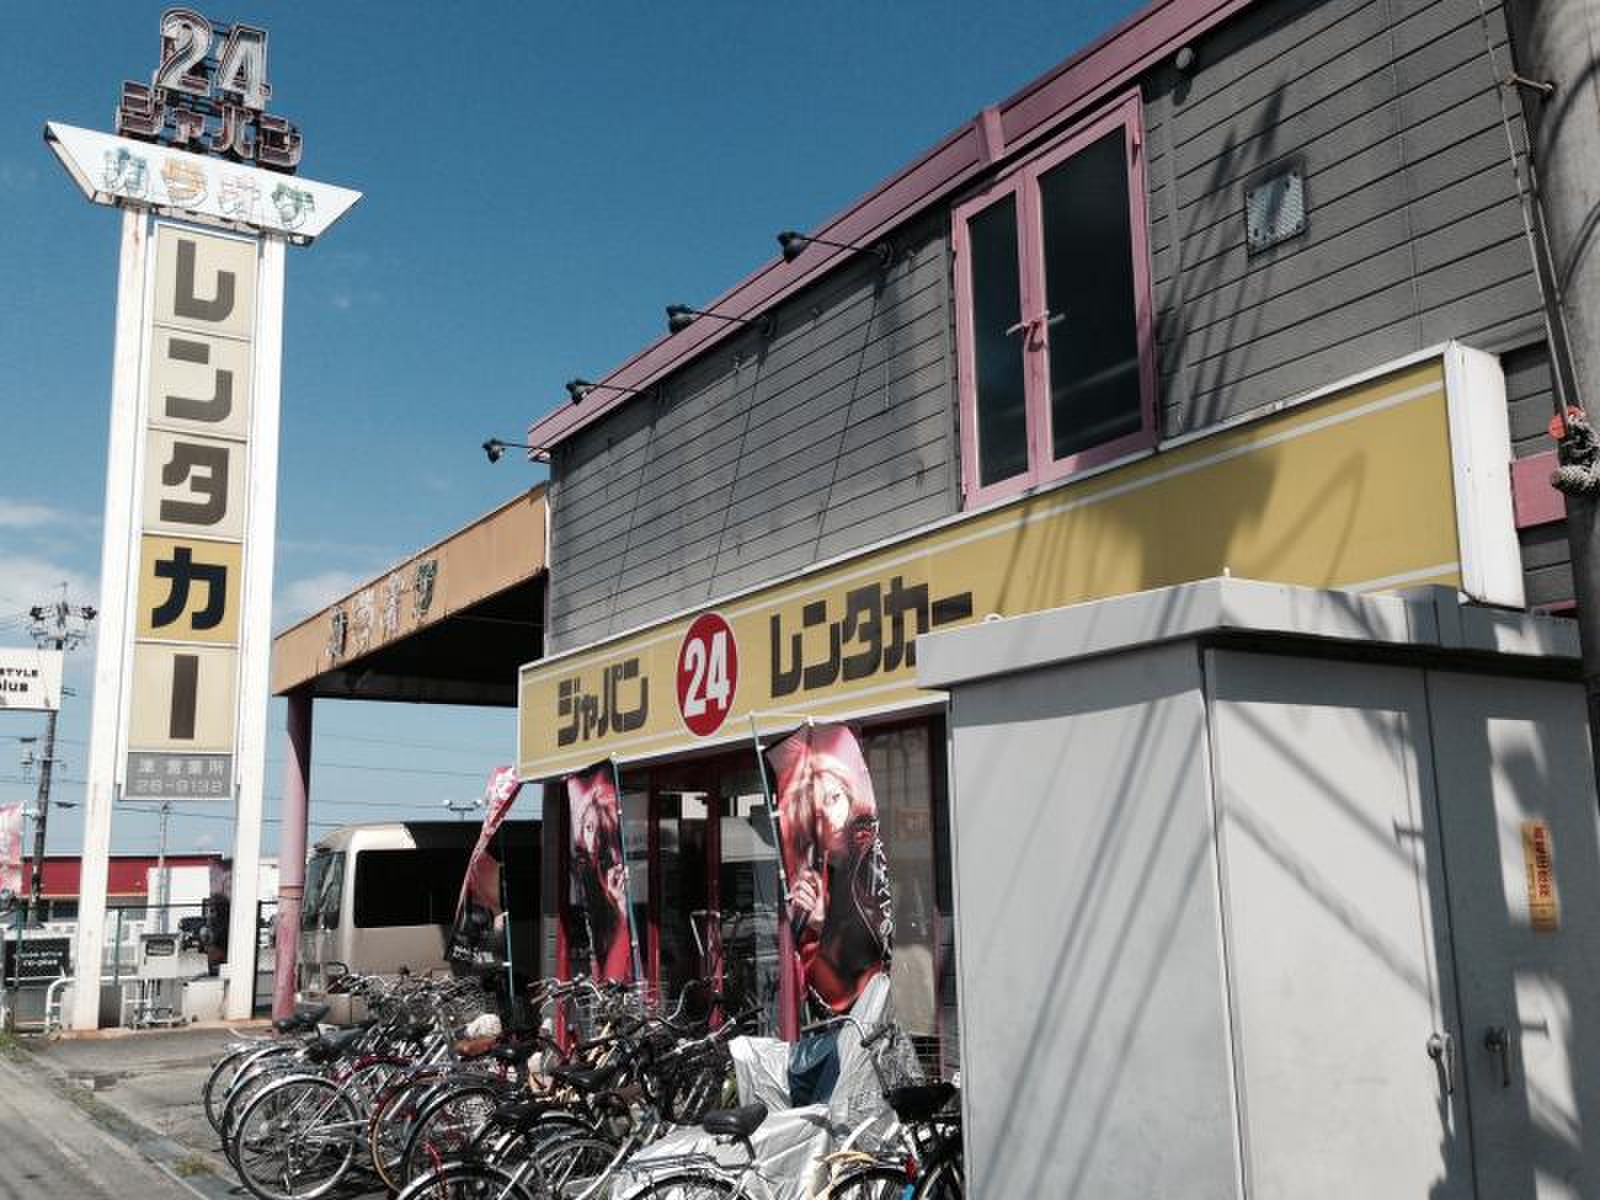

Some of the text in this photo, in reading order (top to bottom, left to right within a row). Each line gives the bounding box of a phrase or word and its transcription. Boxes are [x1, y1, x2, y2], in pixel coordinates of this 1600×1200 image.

[156, 7, 272, 110] 24
[150, 239, 236, 740] レンタカー
[0, 679, 29, 692] lus
[557, 575, 974, 748] ジャパン 24 レンタカー
